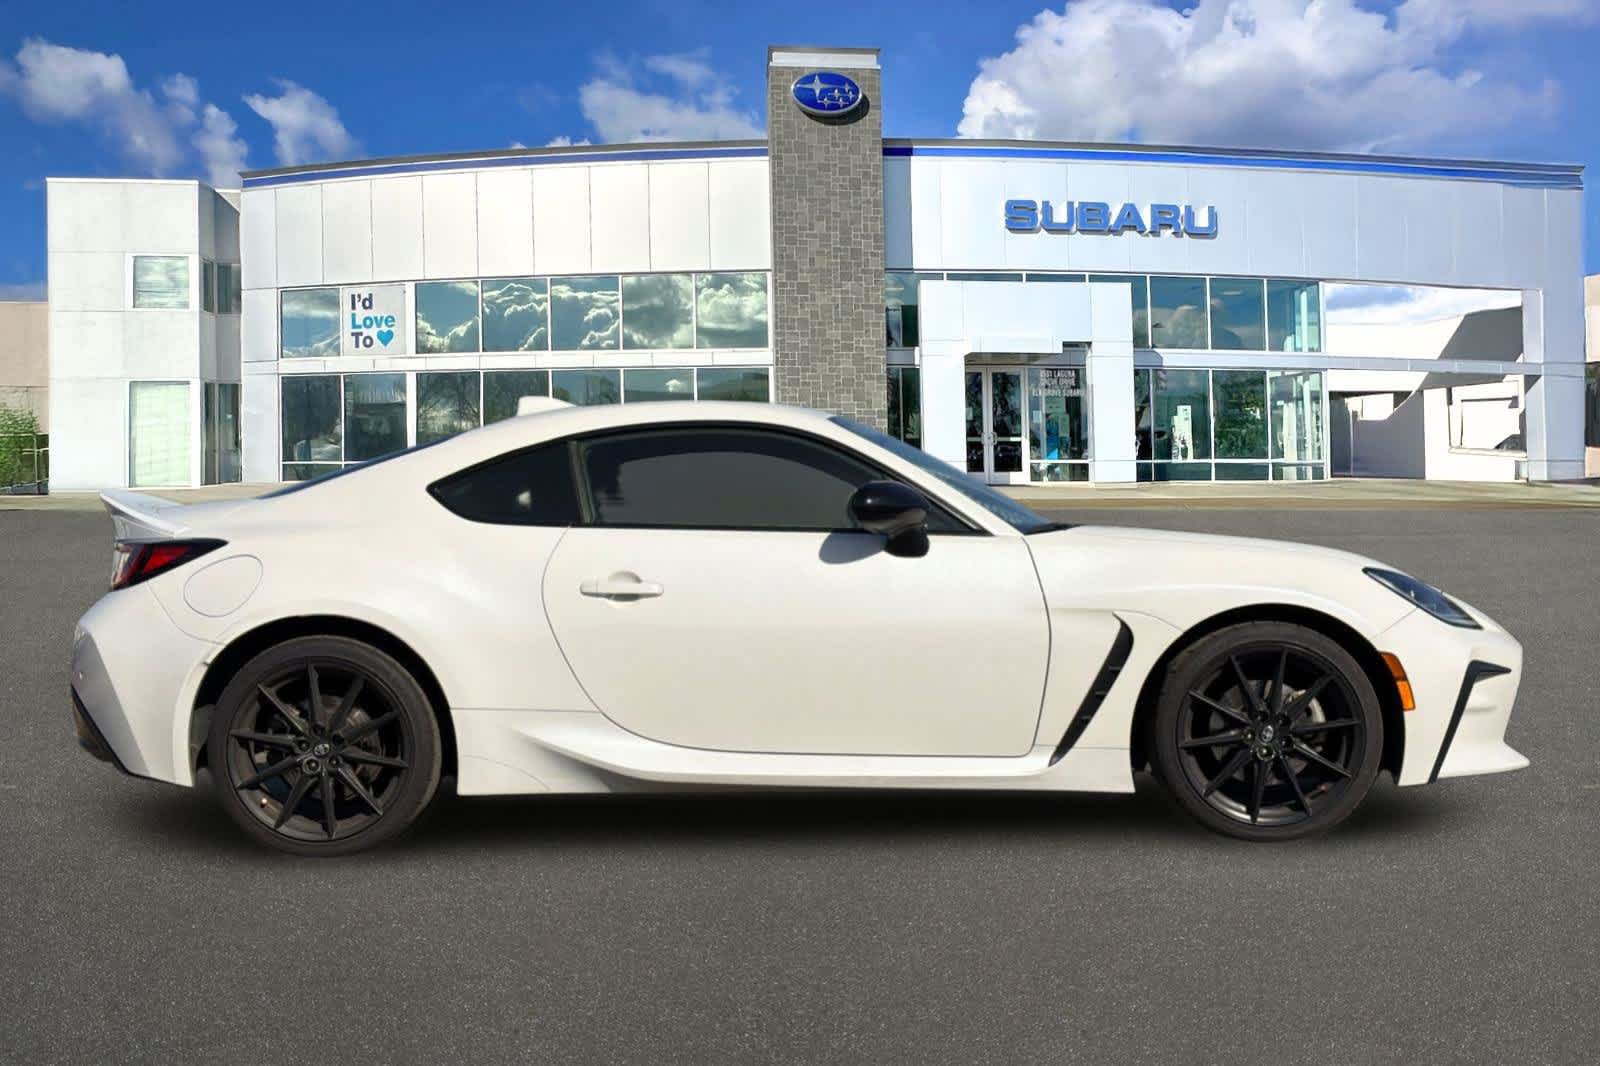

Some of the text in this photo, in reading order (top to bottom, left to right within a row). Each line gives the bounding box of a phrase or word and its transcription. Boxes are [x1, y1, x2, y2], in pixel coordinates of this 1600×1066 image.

[1005, 199, 1217, 238] SUBARU
[351, 293, 373, 310] I’d
[351, 312, 396, 329] Love
[351, 332, 374, 348] To
